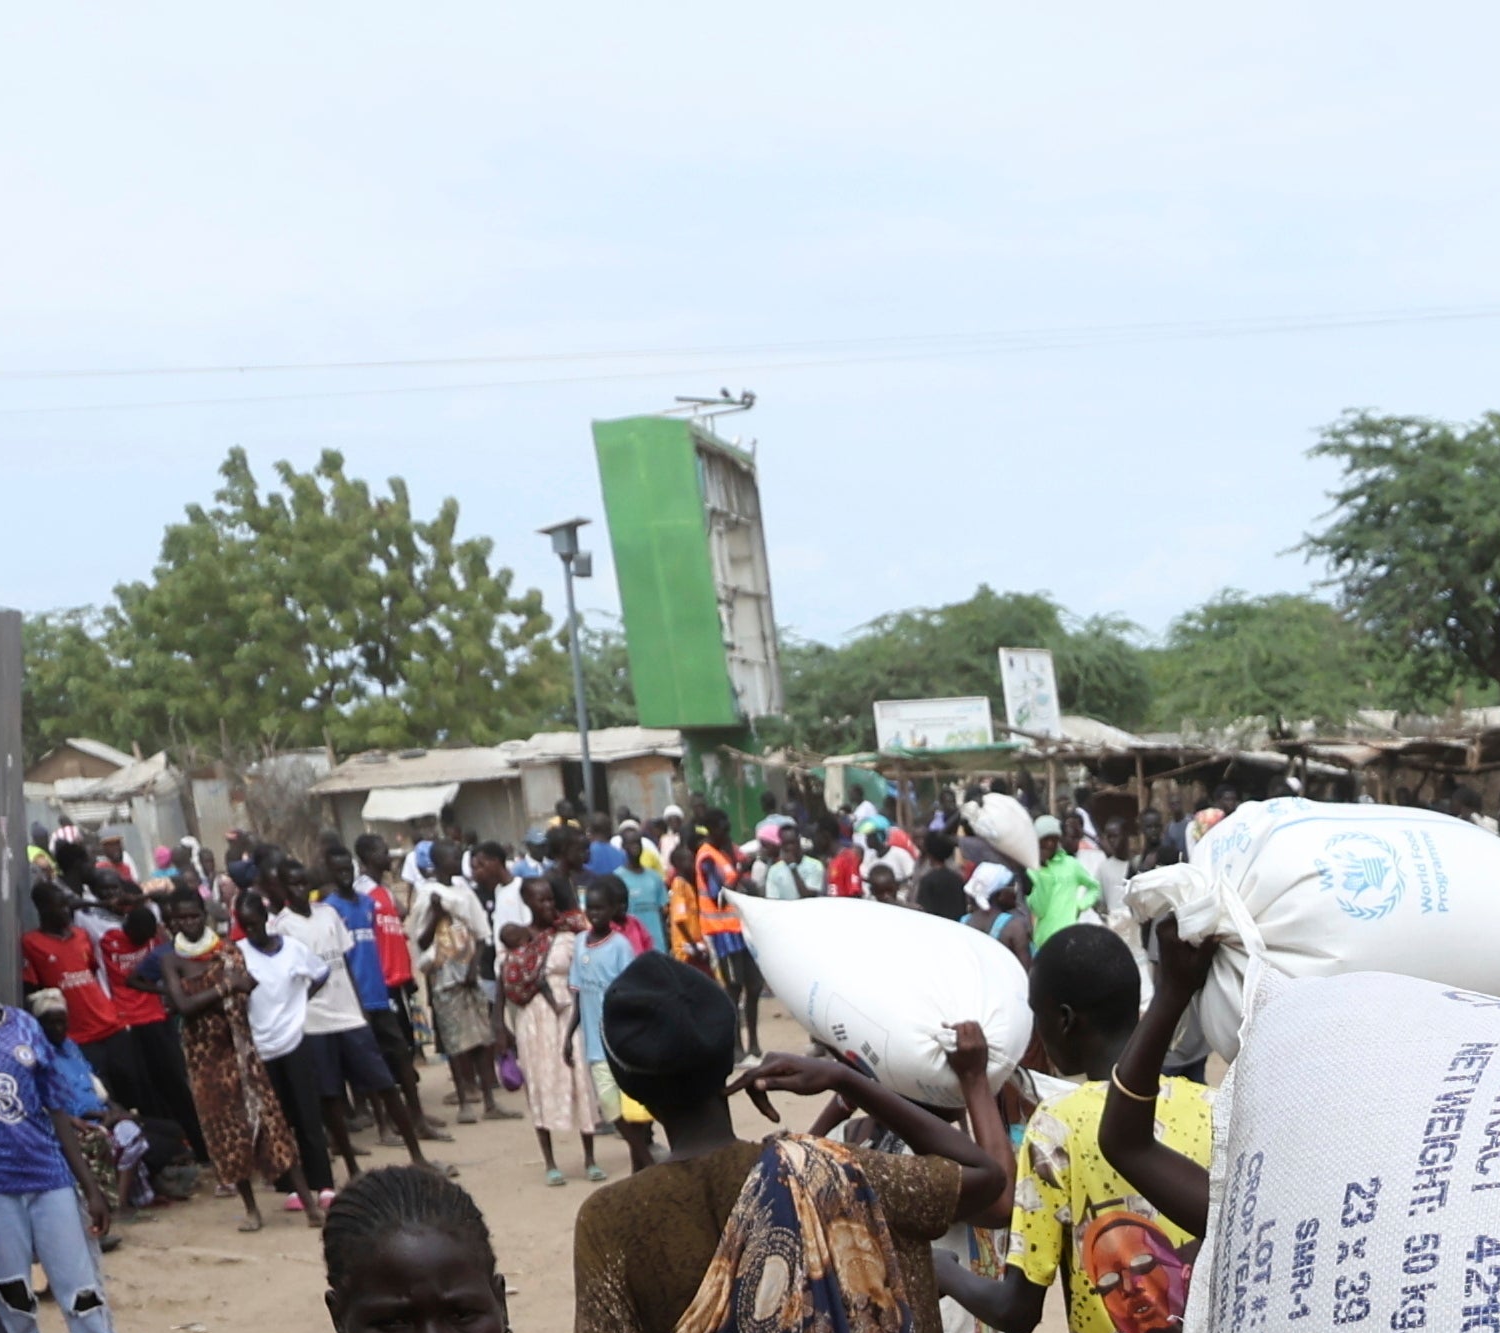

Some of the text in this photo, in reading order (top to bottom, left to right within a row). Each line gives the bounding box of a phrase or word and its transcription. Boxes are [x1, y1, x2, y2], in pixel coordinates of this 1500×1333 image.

[1414, 862, 1433, 914] World
[1443, 1042, 1498, 1084] NET
[1407, 1087, 1476, 1218] WEIGHT:
[1240, 1150, 1265, 1237] CROP
[1253, 1218, 1276, 1285] LOT
[1288, 1217, 1320, 1320] SMR-1
[1332, 1176, 1382, 1327] 23 x 39
[1402, 1233, 1442, 1275] 50
